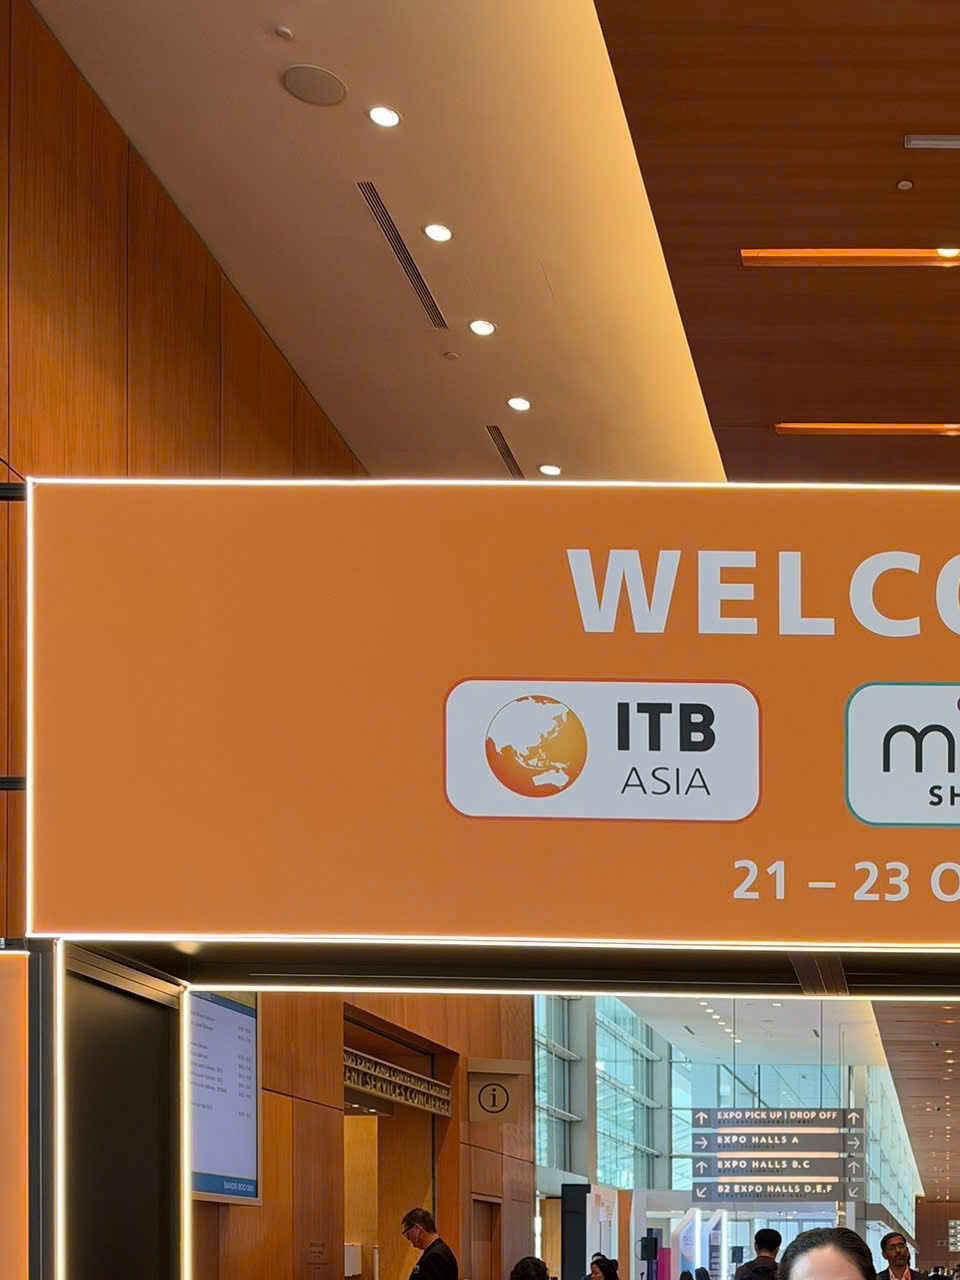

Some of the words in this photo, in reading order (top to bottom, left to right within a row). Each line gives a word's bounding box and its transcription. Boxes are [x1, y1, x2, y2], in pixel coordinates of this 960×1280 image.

[616, 701, 716, 753] ITB
[620, 766, 712, 796] ASIA
[732, 860, 786, 900] 21
[853, 861, 910, 902] 23
[717, 1111, 742, 1120] EXPO
[745, 1111, 767, 1120] PICK
[770, 1111, 783, 1120] UP
[789, 1111, 817, 1120] DROP
[818, 1111, 838, 1120] OFF
[717, 1135, 748, 1144] EXPO
[751, 1135, 788, 1144] HALLS
[791, 1135, 800, 1144] A
[717, 1160, 748, 1169] EXPO
[751, 1160, 788, 1169] HALLS
[717, 1184, 731, 1194] B2
[733, 1184, 763, 1193] EXPO
[766, 1184, 801, 1194] HALLS
